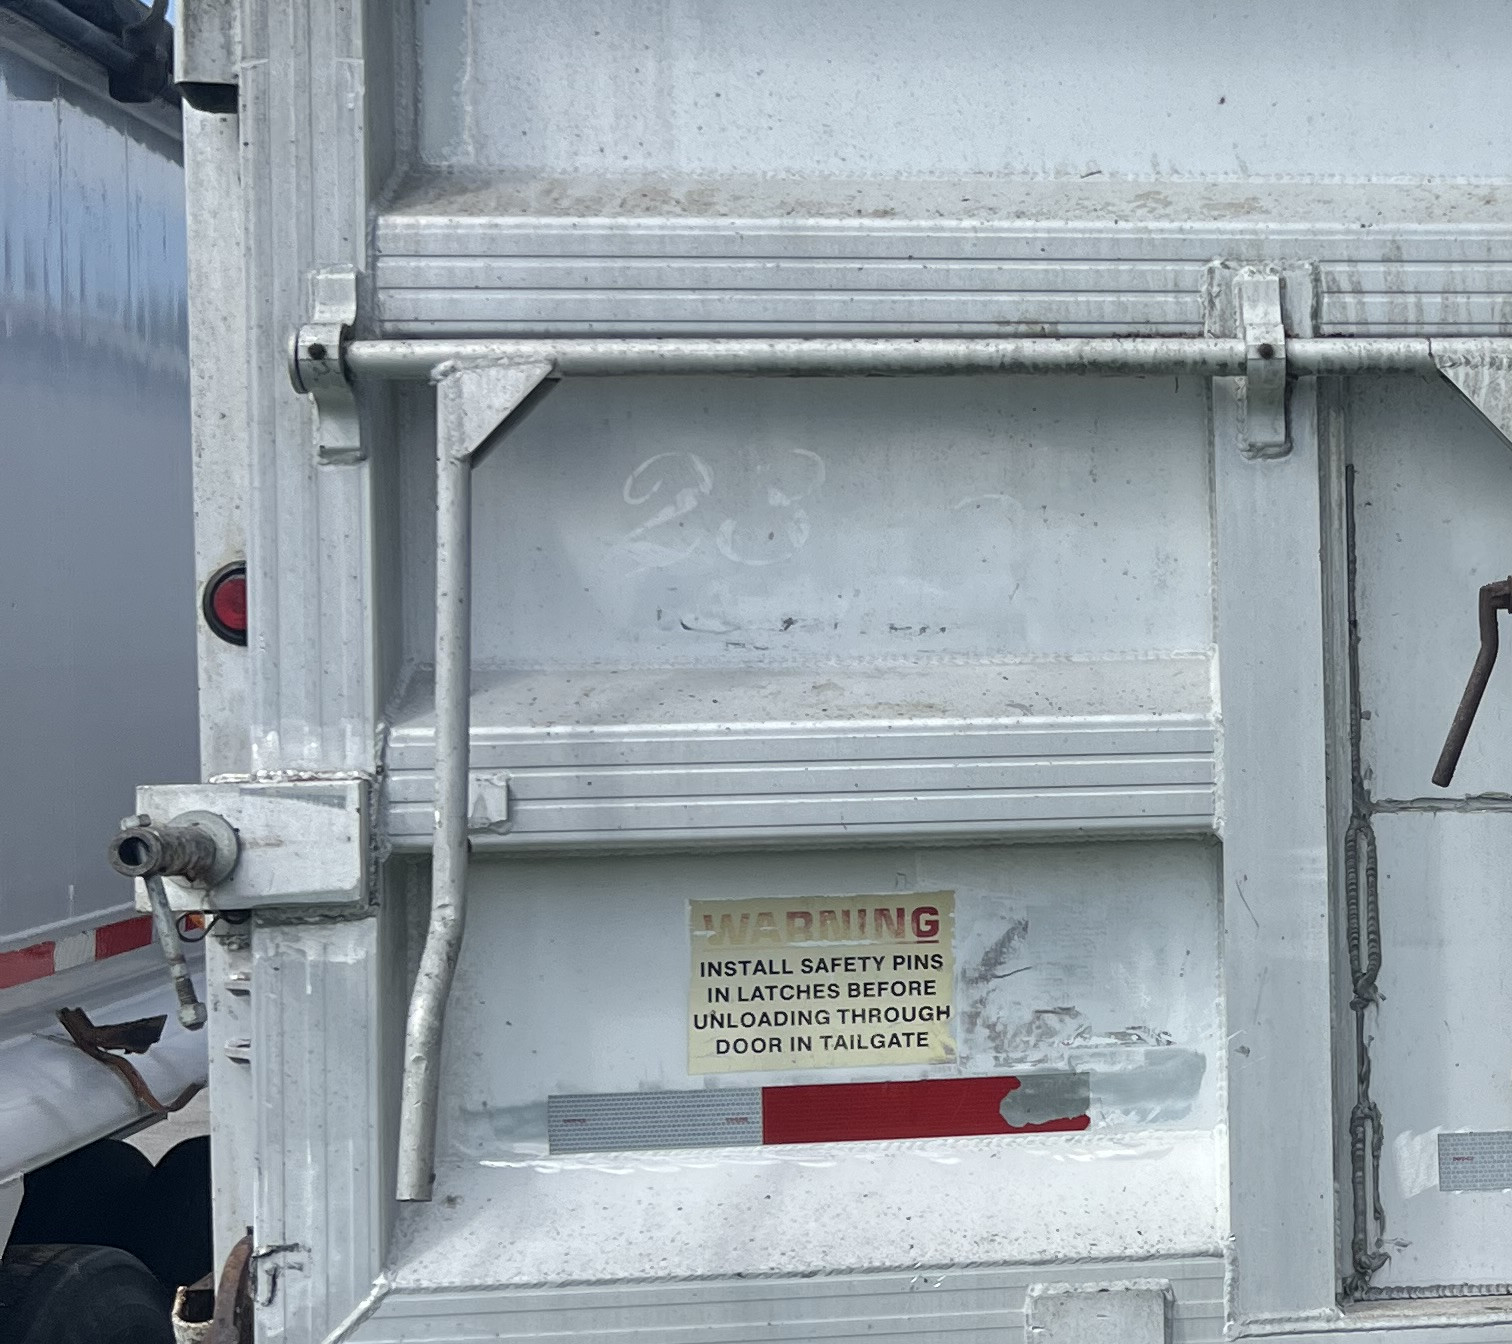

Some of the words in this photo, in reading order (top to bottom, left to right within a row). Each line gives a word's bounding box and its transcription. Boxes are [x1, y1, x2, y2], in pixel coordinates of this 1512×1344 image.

[703, 906, 940, 945] WARNING
[700, 958, 794, 978] INSTALL
[800, 955, 886, 974] SAFETY
[892, 953, 944, 972] PINS
[707, 987, 730, 1003] IN
[737, 983, 840, 1002] LATCHES
[848, 979, 937, 998] BEFORE
[693, 1008, 831, 1030] UNLOADING
[836, 1005, 951, 1025] THROUGH
[716, 1037, 782, 1055] DOOR
[790, 1036, 812, 1052] IN
[819, 1031, 930, 1051] TAILGATE
